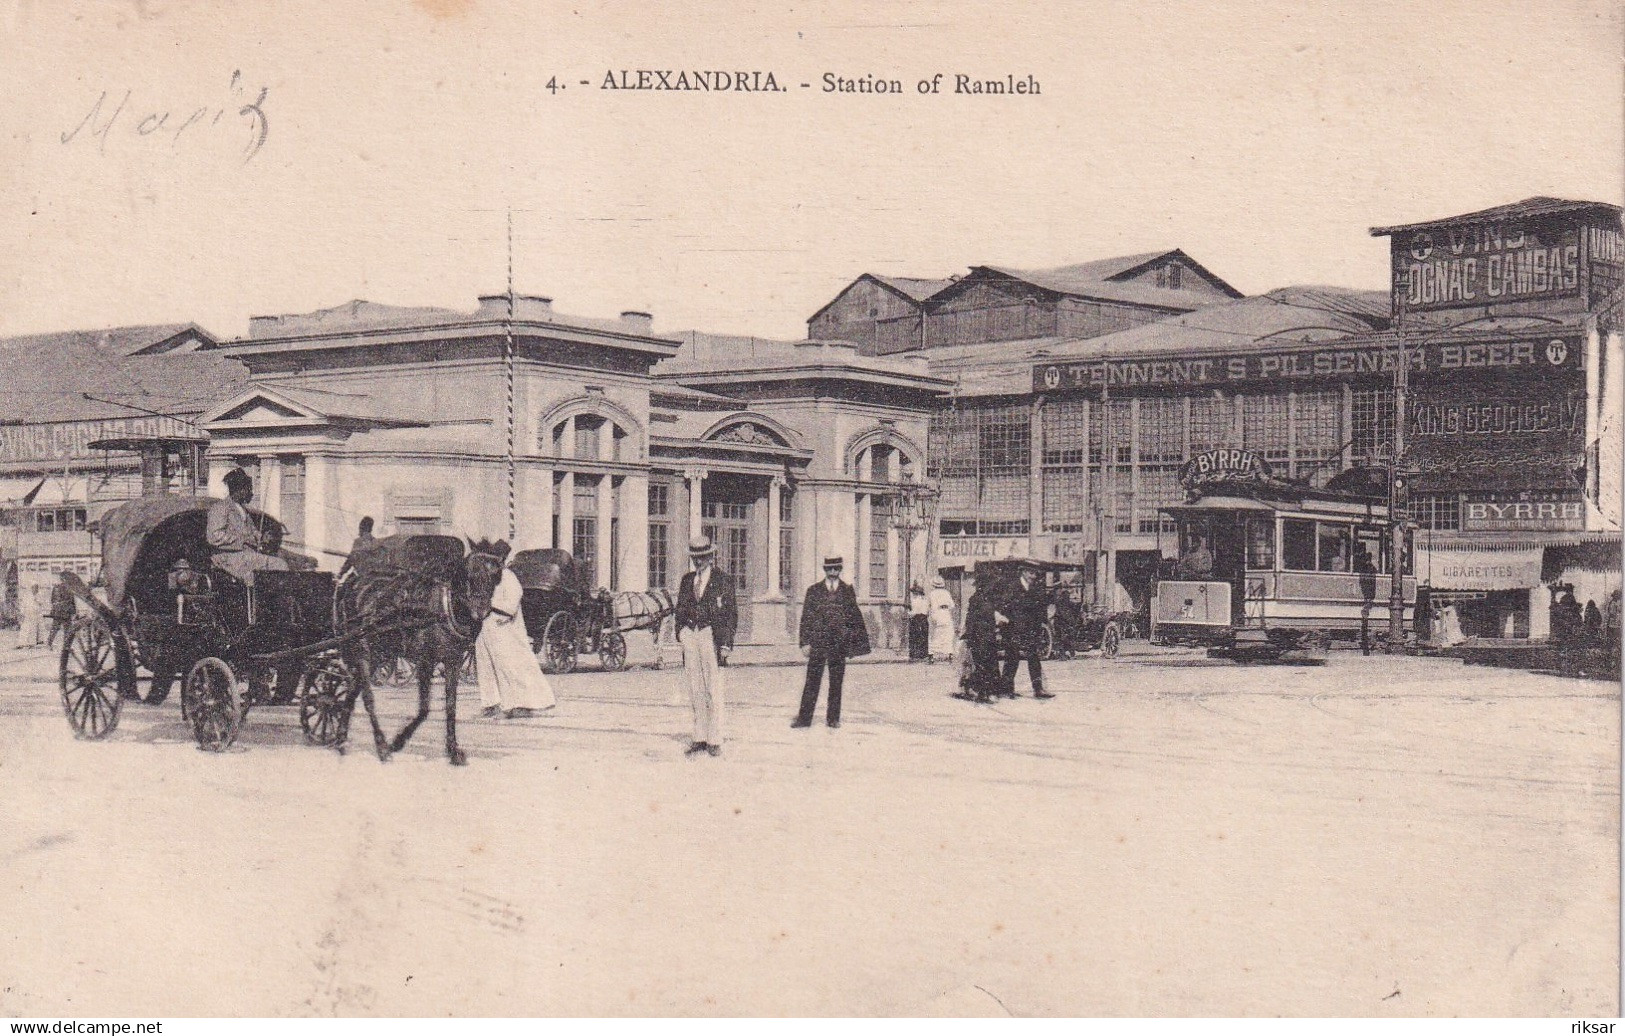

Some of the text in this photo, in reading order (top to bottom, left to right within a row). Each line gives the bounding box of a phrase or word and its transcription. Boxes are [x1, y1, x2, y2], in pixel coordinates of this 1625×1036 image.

[1407, 245, 1577, 305] OGNAC CAMBAS
[1440, 342, 1536, 368] BEER
[1465, 400, 1551, 433] GEORGE
[1197, 449, 1254, 473] BYRRH
[1468, 502, 1581, 519] BYRRH
[943, 540, 998, 556] CROIZET
[1442, 566, 1513, 579] CIGARETTES
